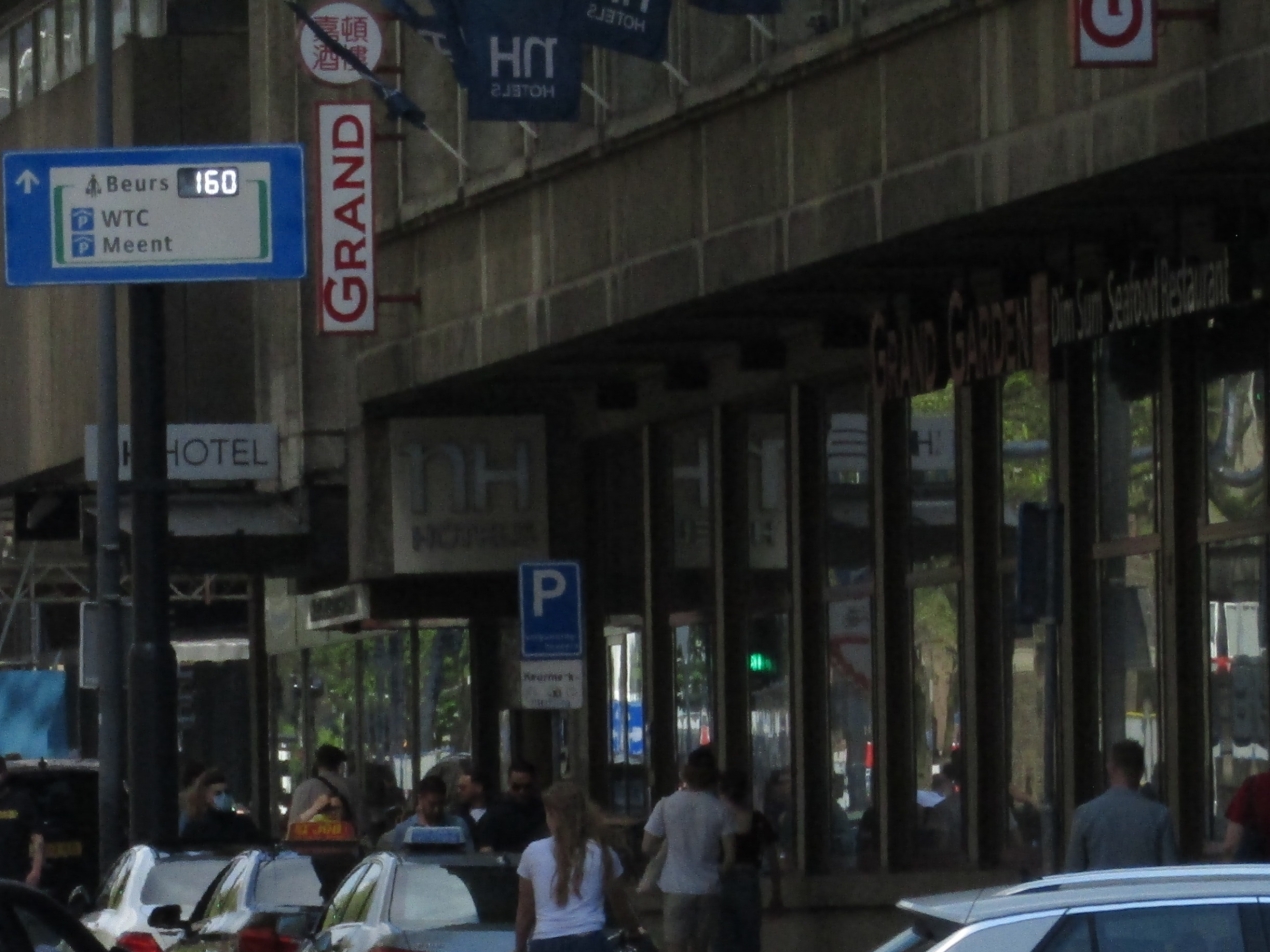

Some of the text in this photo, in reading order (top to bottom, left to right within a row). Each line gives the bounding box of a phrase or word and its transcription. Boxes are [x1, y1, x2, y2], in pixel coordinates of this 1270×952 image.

[106, 169, 237, 195] Beurs 160
[101, 209, 150, 228] WTC
[323, 113, 369, 323] GRAND
[102, 235, 173, 253] Meent
[533, 569, 566, 617] P
